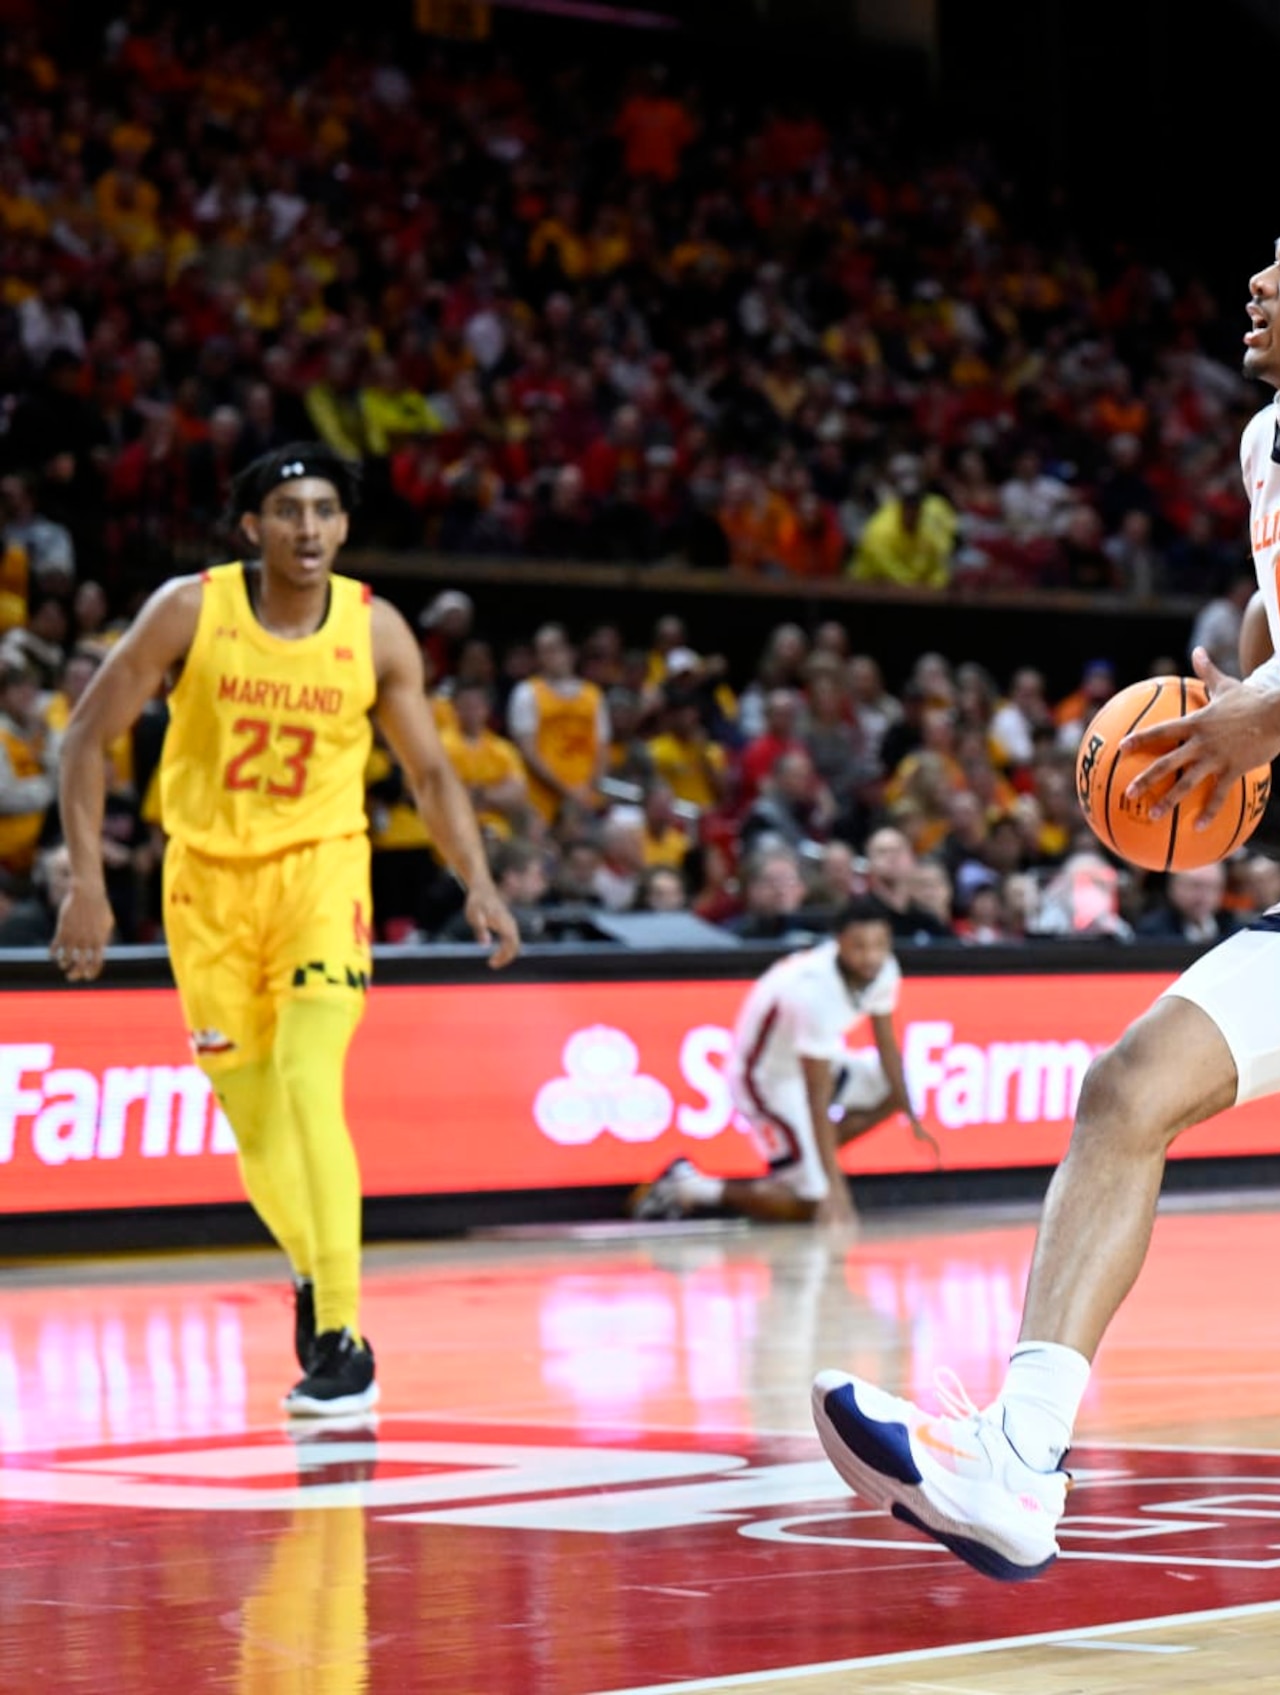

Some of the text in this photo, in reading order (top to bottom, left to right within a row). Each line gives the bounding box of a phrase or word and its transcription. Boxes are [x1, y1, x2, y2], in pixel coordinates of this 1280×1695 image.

[218, 675, 343, 716] MARYLAND
[224, 717, 315, 799] 23
[0, 1042, 237, 1166] Farm
[904, 1020, 1096, 1130] Farm
